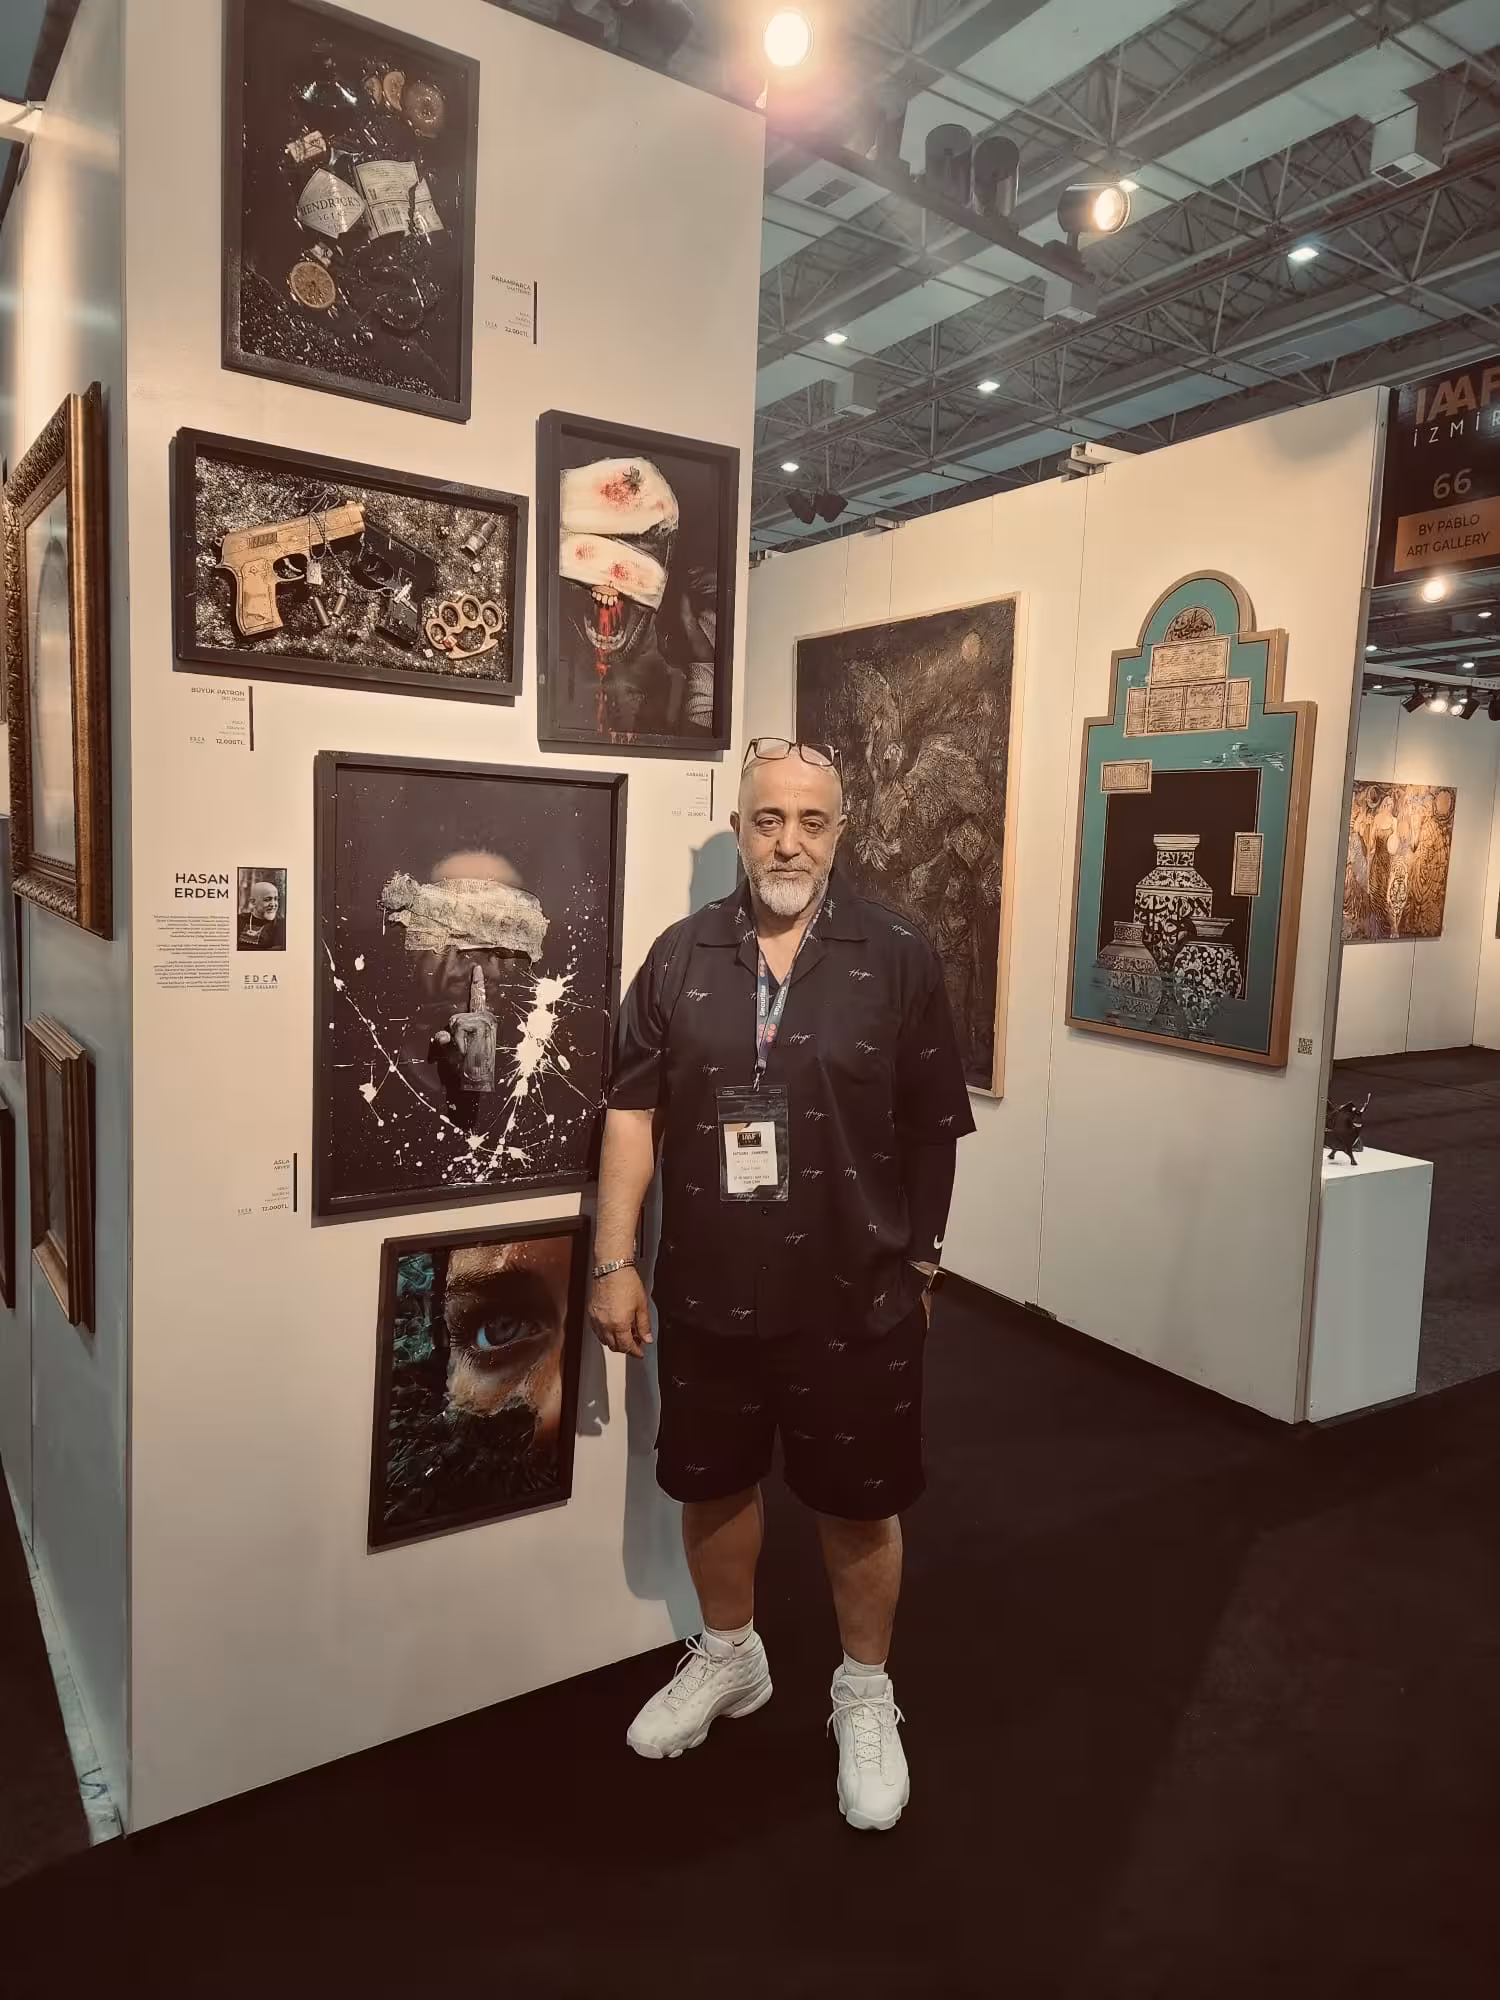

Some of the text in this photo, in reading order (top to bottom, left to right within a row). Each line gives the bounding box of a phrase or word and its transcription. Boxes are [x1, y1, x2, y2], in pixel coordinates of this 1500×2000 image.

[1432, 467, 1473, 499] 66
[1419, 513, 1480, 536] BY PABLO
[1406, 531, 1490, 557] ART GALLERY
[175, 873, 229, 885] HASAN
[174, 888, 229, 899] ERDEM
